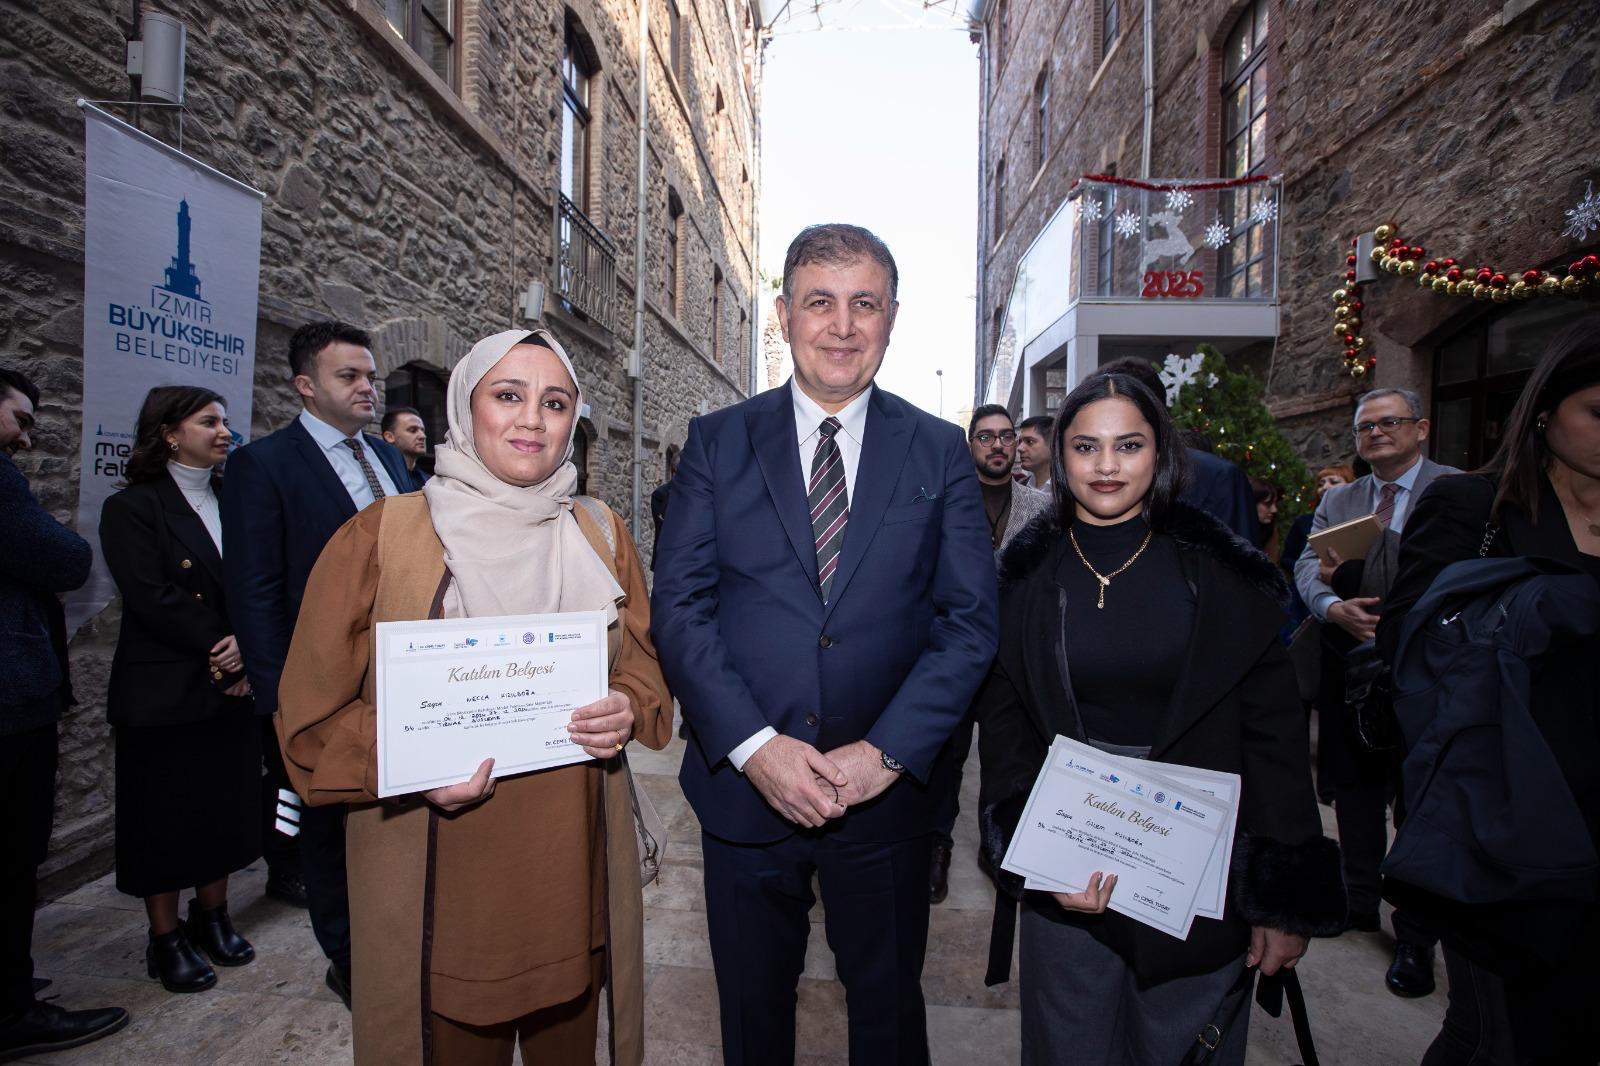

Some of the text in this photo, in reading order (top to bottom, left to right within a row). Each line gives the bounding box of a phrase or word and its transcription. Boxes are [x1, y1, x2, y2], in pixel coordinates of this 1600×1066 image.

[1141, 271, 1204, 298] 2025
[151, 288, 212, 324] İZMİR
[109, 302, 245, 356] BÜYÜKŞEHİR
[116, 332, 238, 376] BELEDİYESİ
[447, 660, 556, 683] Katılım Belgesi
[1083, 792, 1126, 819] Katılım
[1127, 810, 1173, 837] Belgesi
